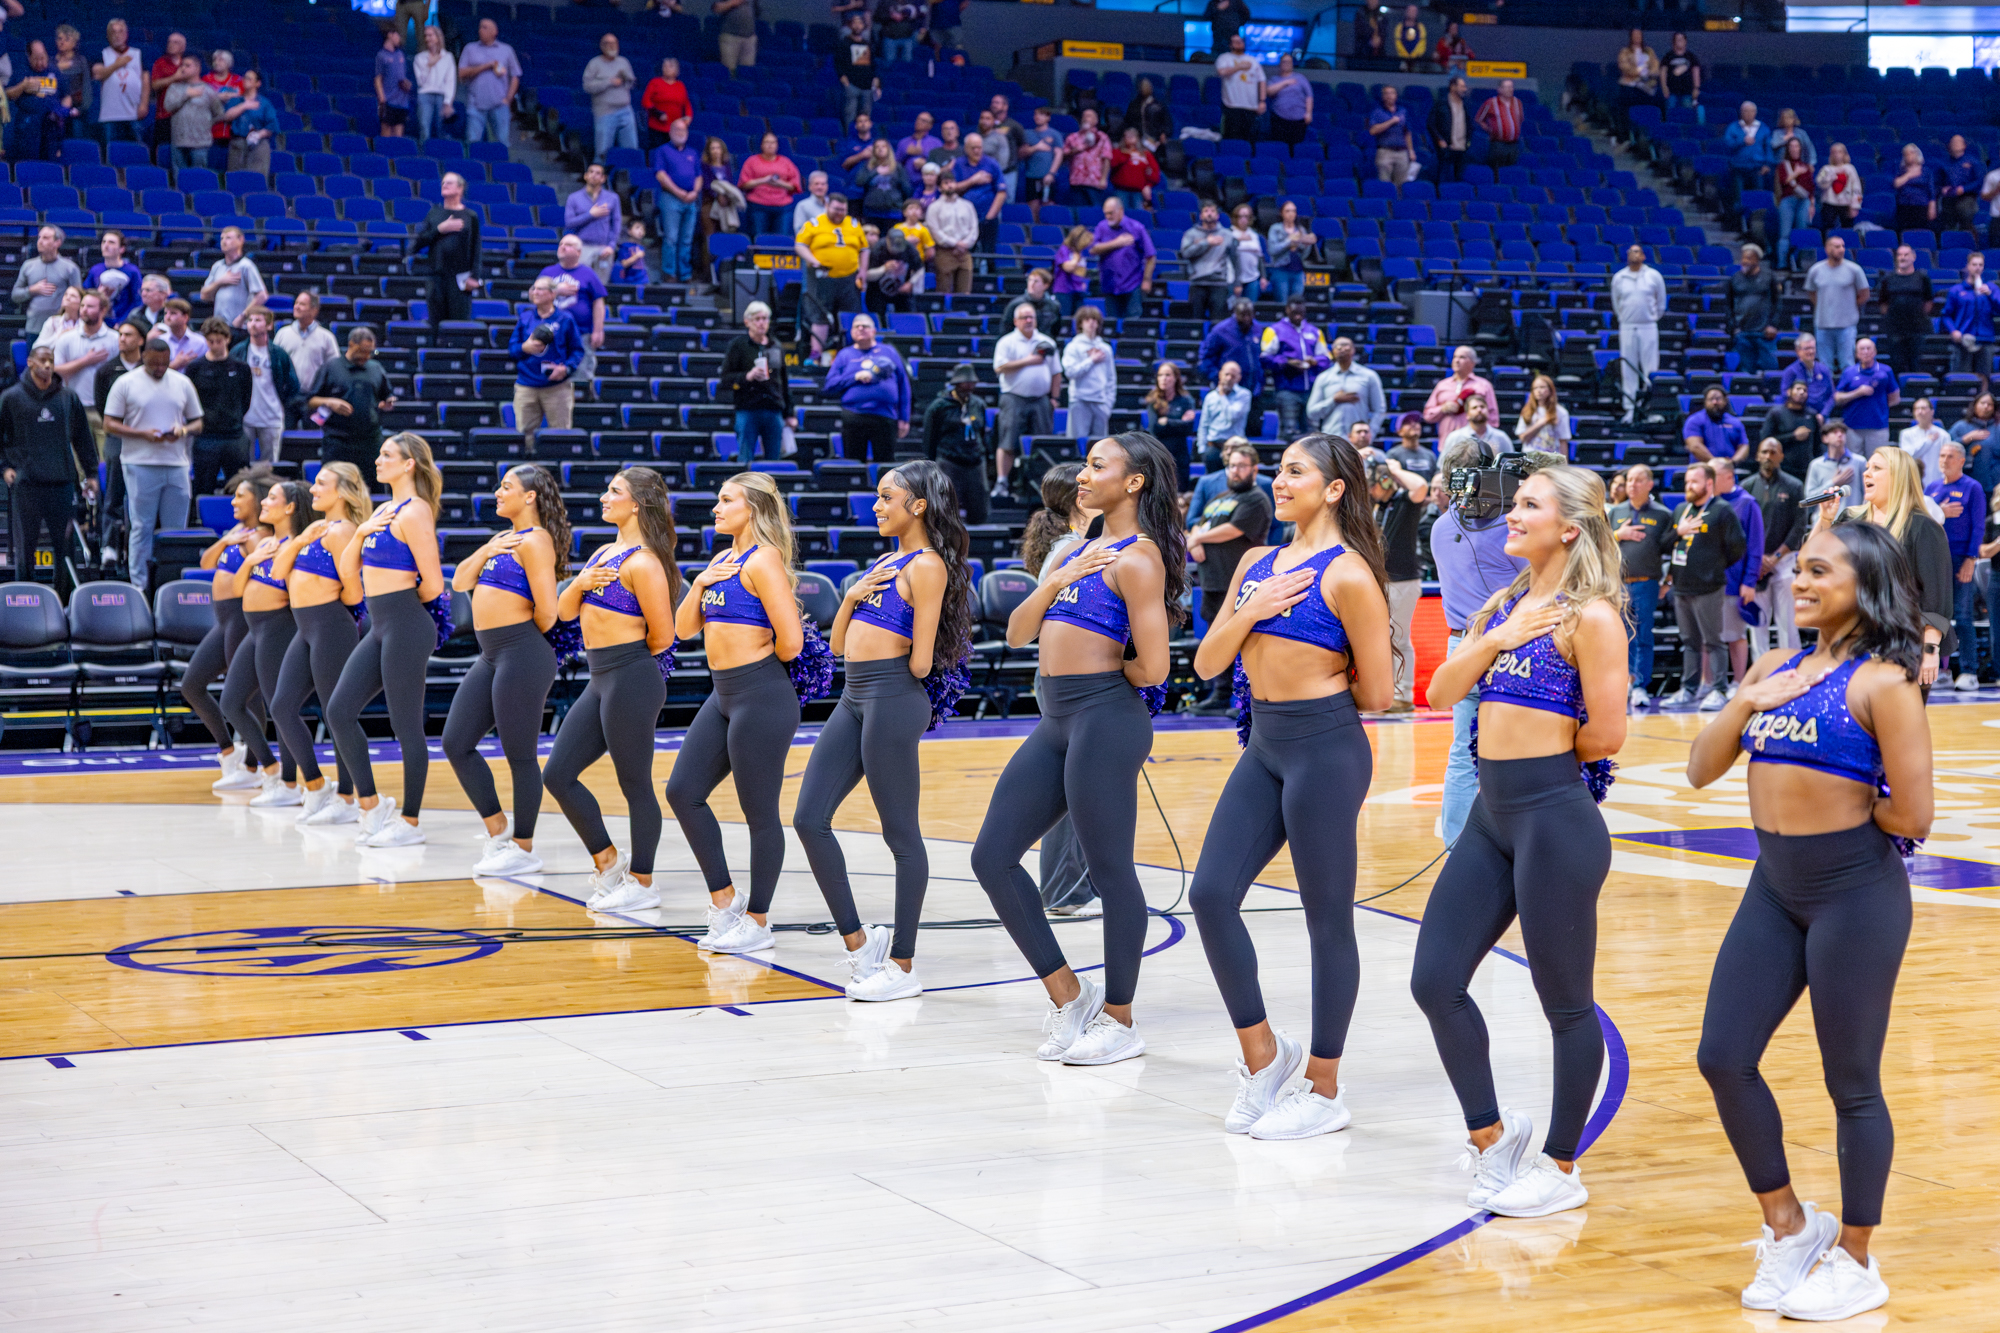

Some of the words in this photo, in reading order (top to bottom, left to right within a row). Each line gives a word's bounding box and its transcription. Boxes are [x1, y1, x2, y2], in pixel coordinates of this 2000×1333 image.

[832, 227, 847, 247] 1
[770, 255, 798, 268] 104
[1307, 273, 1326, 285] 04
[6, 594, 40, 607] LSU
[92, 594, 125, 606] LSU
[177, 593, 211, 605] LSU
[701, 589, 725, 611] gers
[1485, 652, 1531, 685] gers
